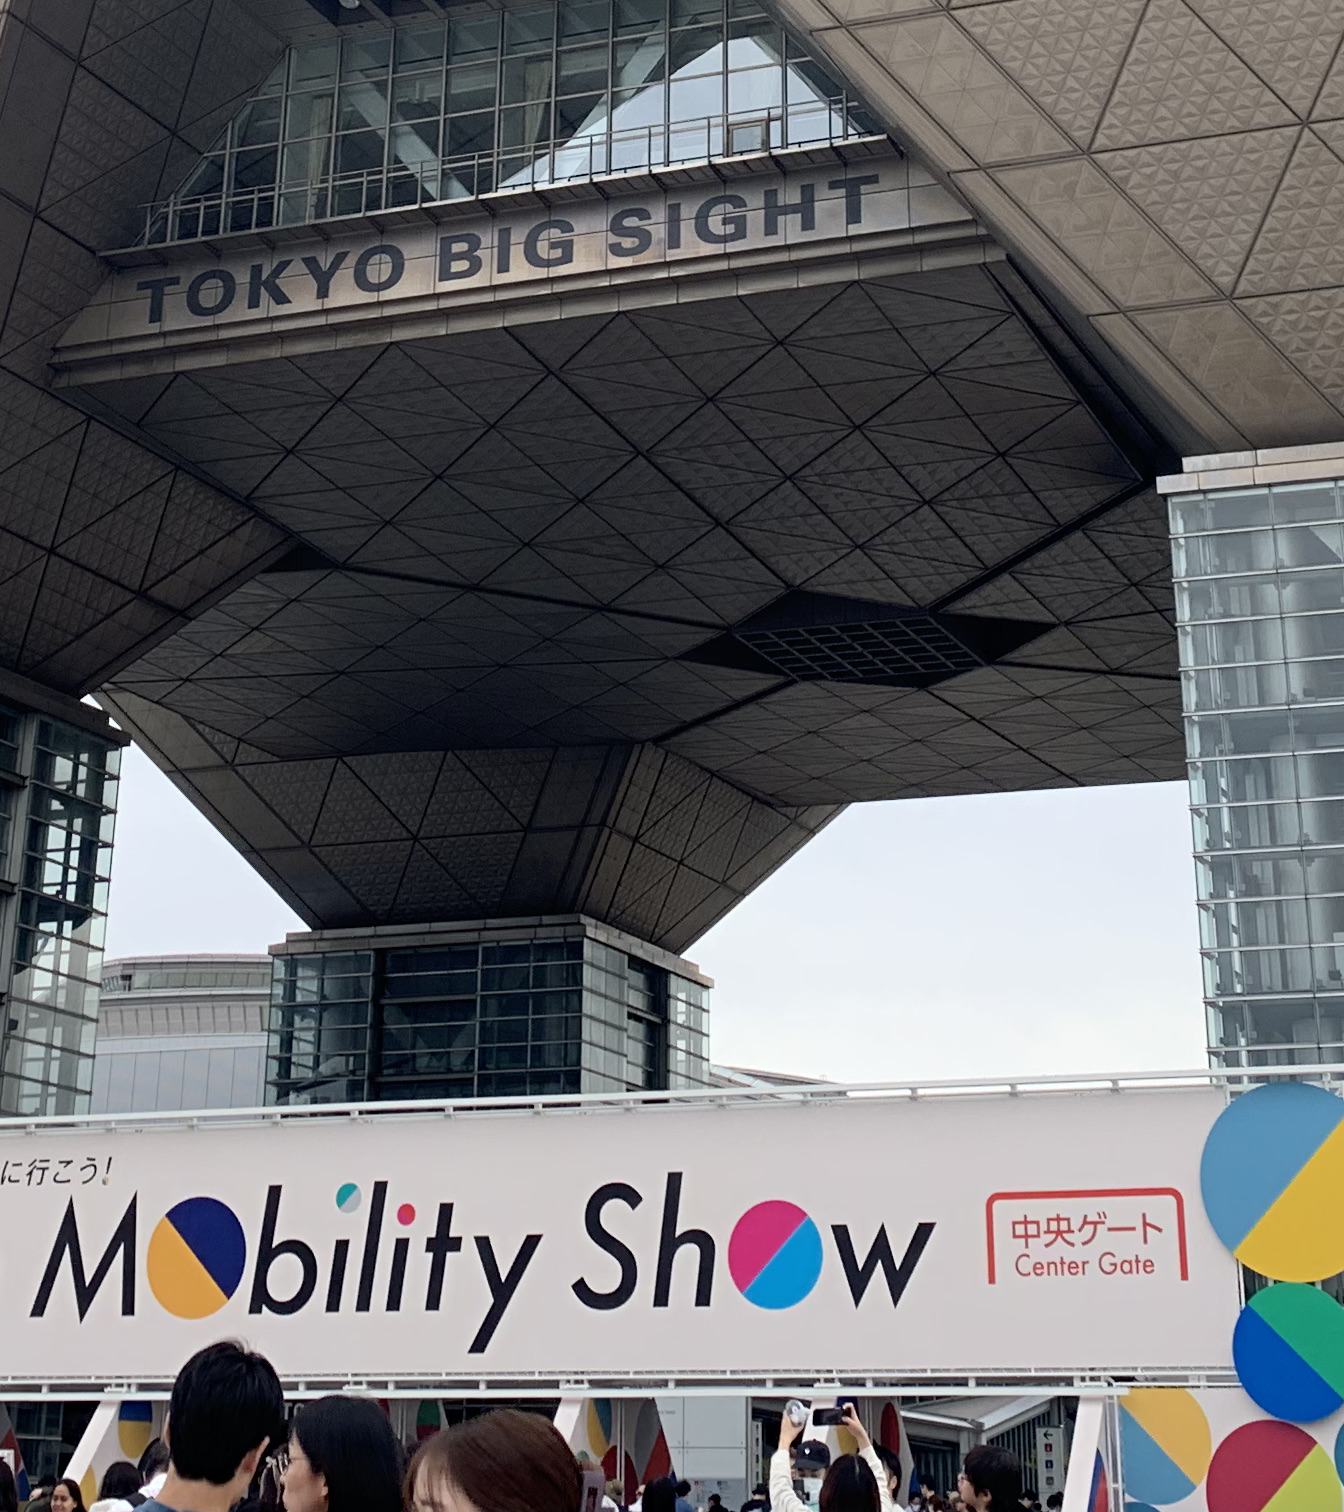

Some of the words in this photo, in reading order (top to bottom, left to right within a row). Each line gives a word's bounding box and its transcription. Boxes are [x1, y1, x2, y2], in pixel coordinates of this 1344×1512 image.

[135, 244, 404, 325] TOKYO
[438, 219, 575, 284] BIG
[607, 173, 880, 259] SIGHT
[29, 1179, 544, 1354] Mobility
[570, 1171, 937, 1311] Show
[1011, 1211, 1163, 1249] 中央ゲート
[1015, 1253, 1090, 1277] Center
[1098, 1251, 1155, 1275] Gate
